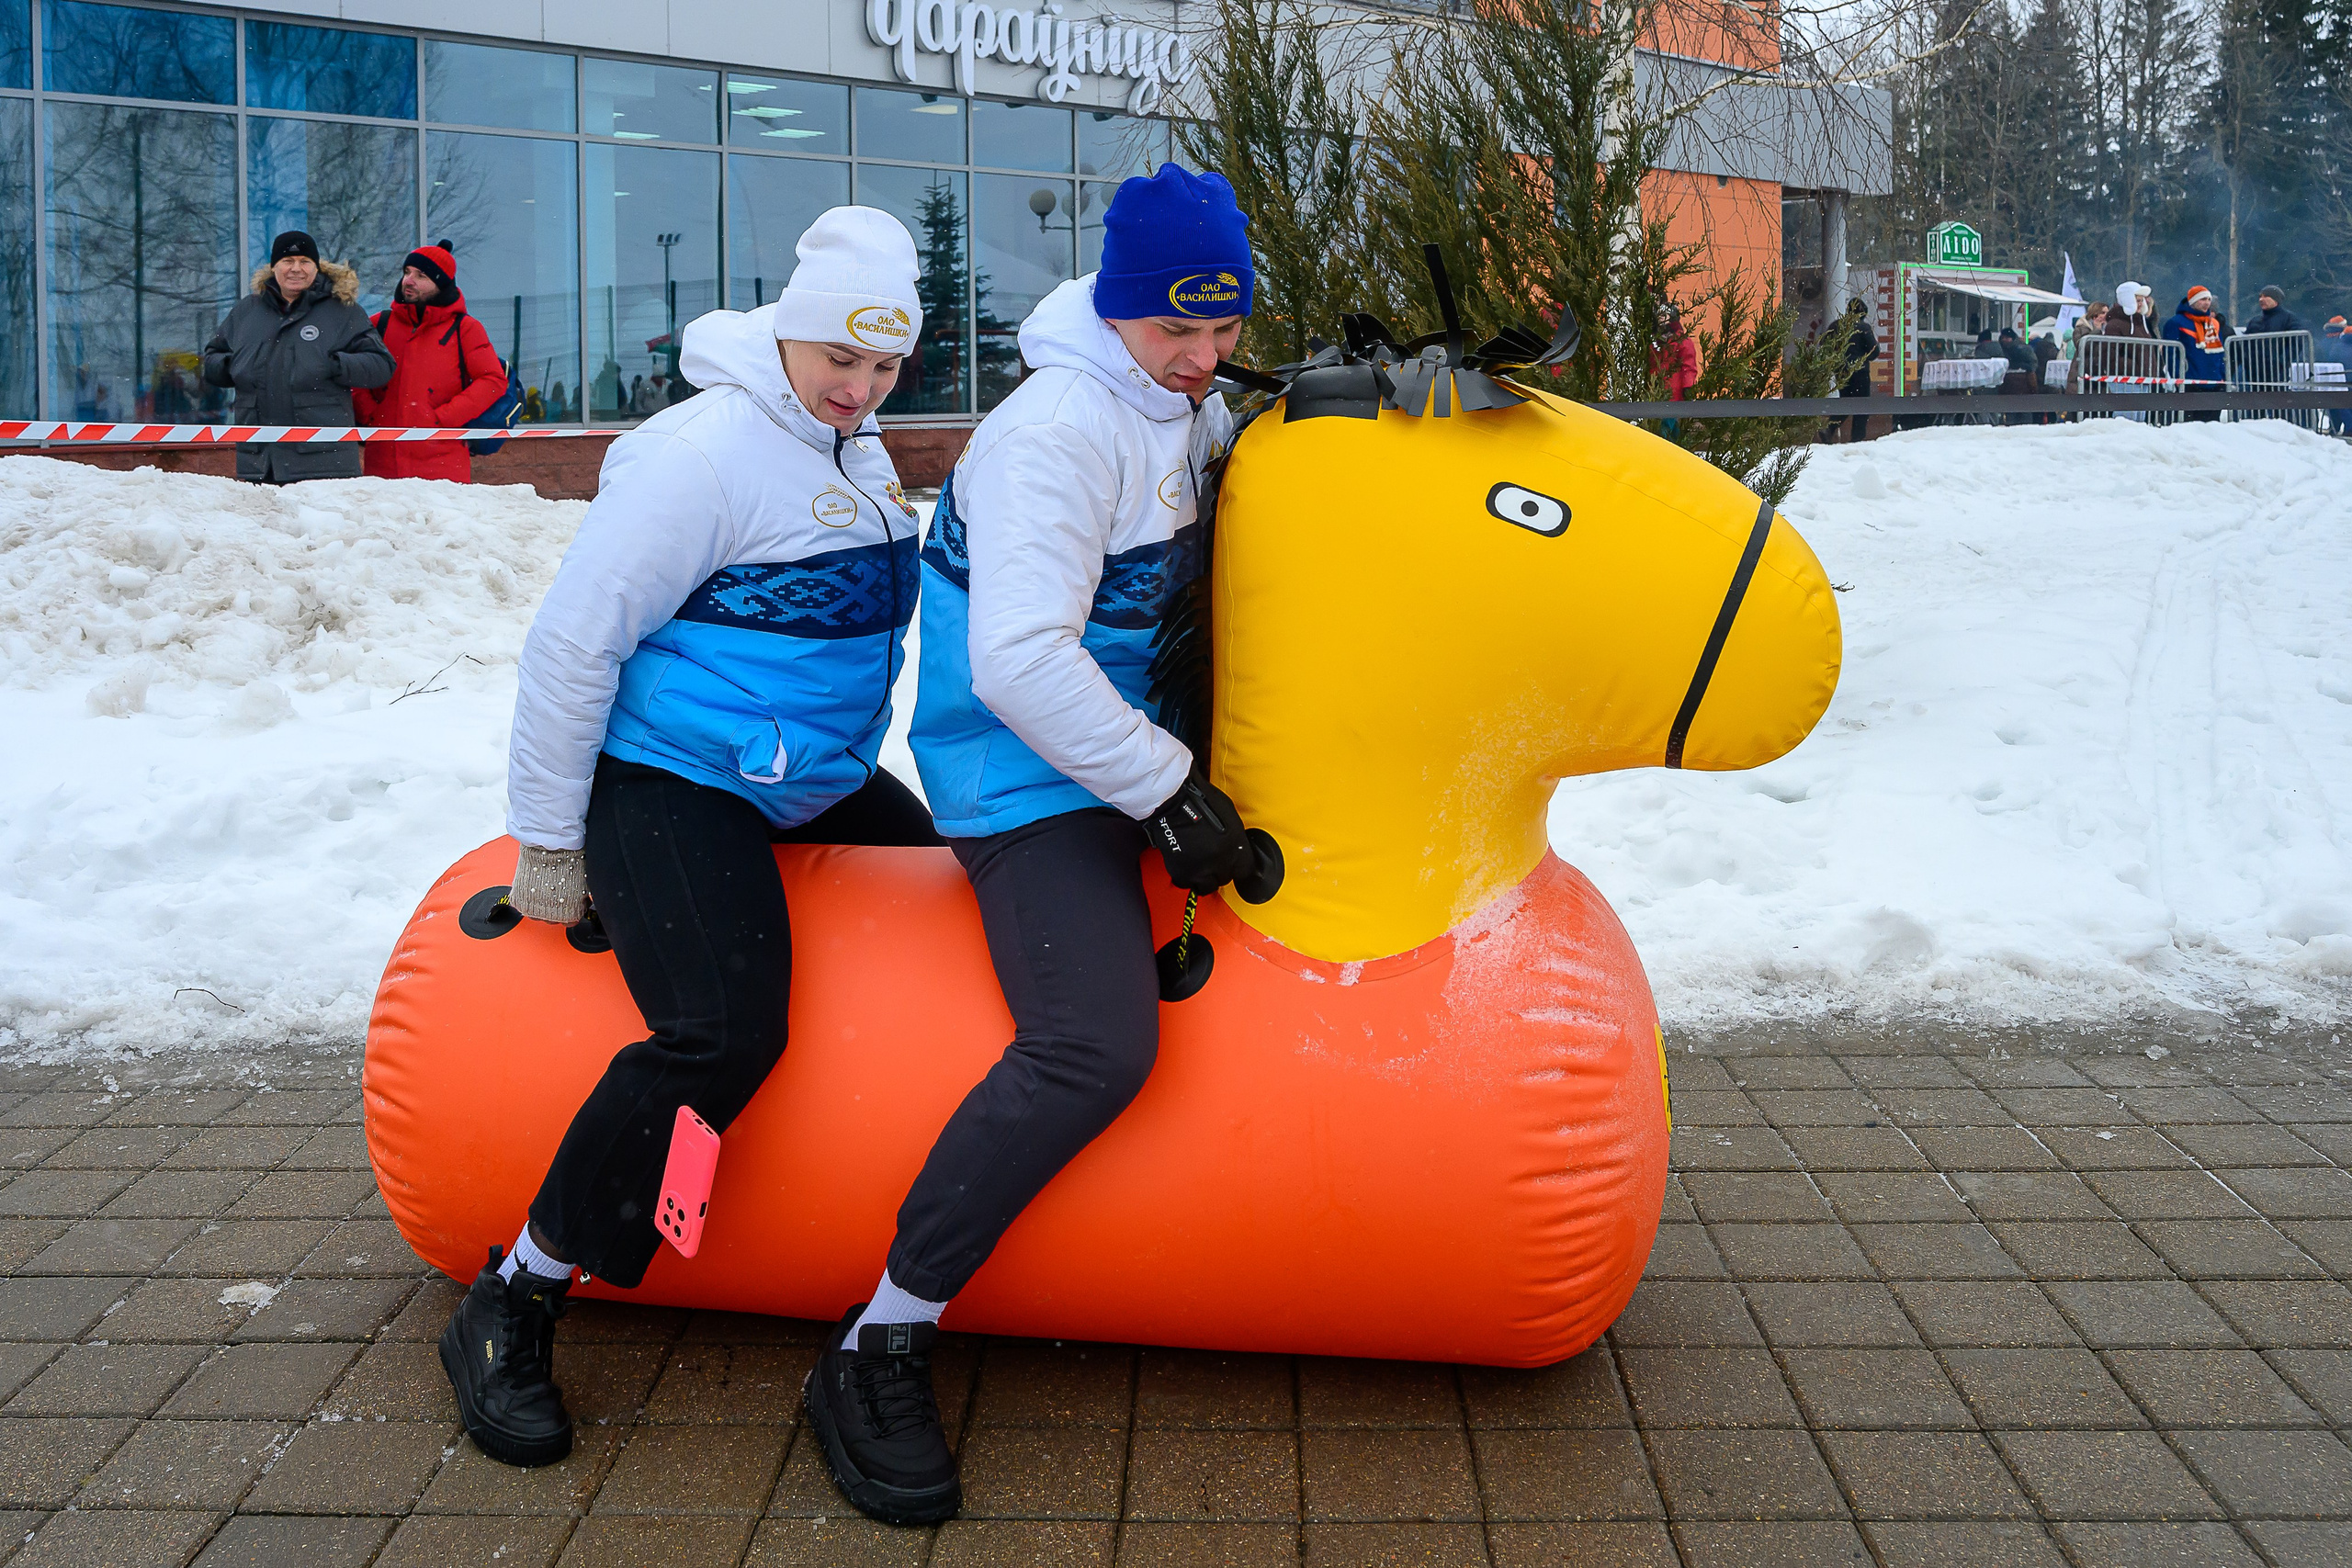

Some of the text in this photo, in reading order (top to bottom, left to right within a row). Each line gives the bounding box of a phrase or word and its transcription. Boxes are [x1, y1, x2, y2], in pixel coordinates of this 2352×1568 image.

[1200, 283, 1221, 292] ОАО
[877, 315, 895, 326] ОАО
[1159, 817, 1182, 852] SPORT
